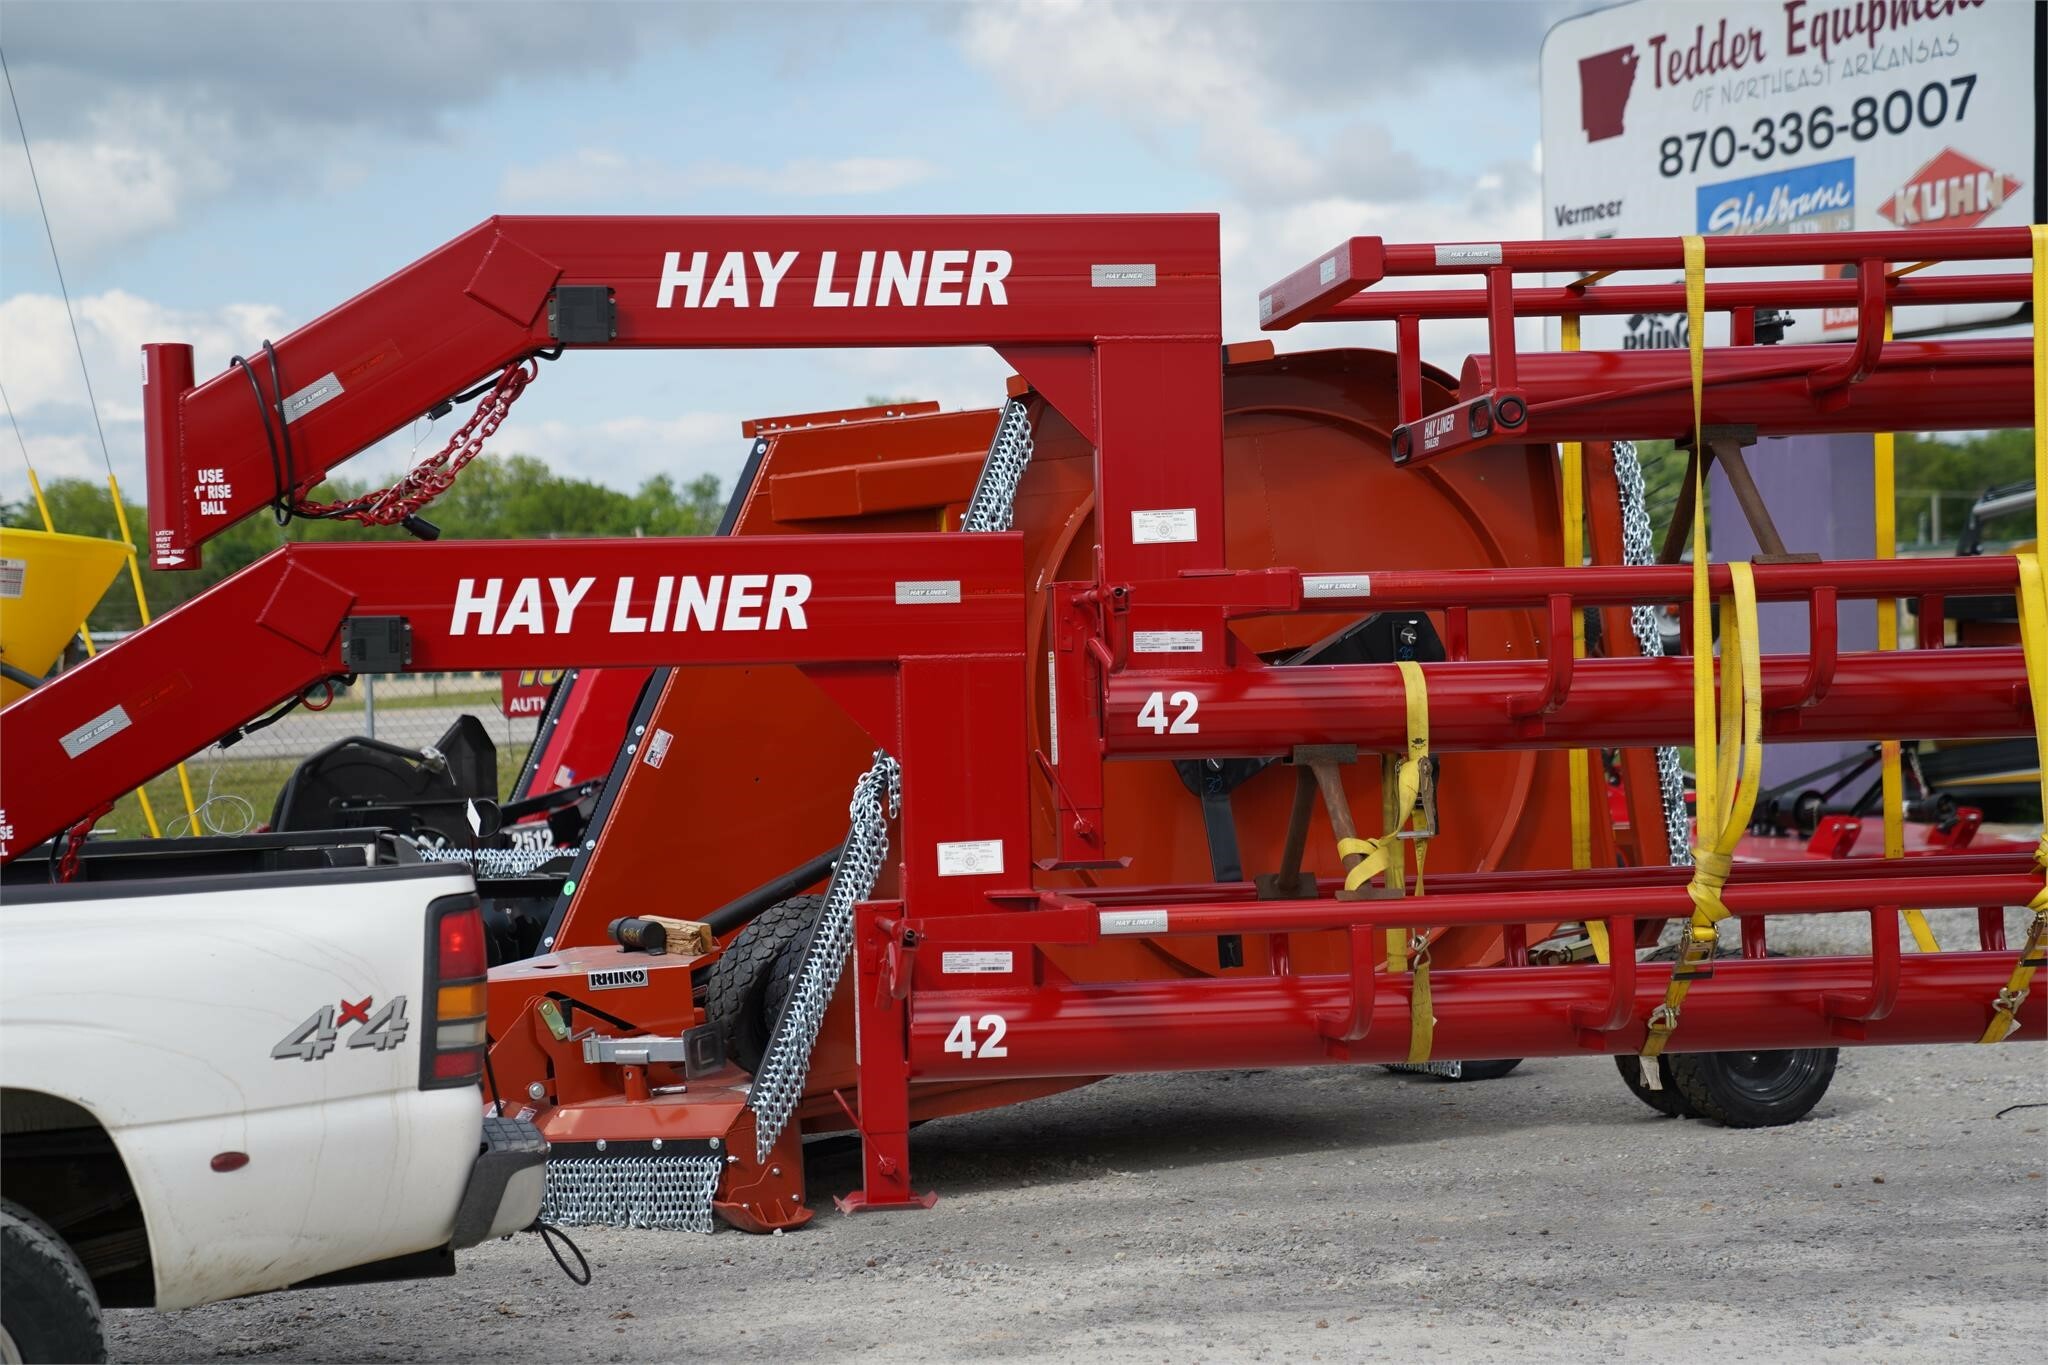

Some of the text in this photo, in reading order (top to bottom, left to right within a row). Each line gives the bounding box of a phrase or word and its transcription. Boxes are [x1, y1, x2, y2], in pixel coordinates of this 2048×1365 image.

[1648, 0, 1986, 90] Tedder Equipme
[1692, 32, 1960, 113] OF NORTHEAST ARKANSAS
[1658, 73, 1978, 179] 870-336-8007
[1555, 199, 1623, 227] Vermeer
[1708, 181, 1852, 236] Shelbourne
[1895, 171, 2004, 227] KUHN
[657, 250, 1013, 308] HAY LINER
[292, 386, 329, 412] HAY LINER
[1424, 413, 1455, 440] HAY LINER
[1424, 436, 1440, 450] TRAILERS
[194, 484, 232, 500] 1" RISE
[197, 468, 225, 484] USE
[200, 500, 227, 515] BALL
[449, 573, 812, 636] HAY LINER
[1137, 690, 1200, 735] 42
[511, 828, 555, 852] 2512
[590, 969, 646, 987] RHINO
[944, 1013, 1008, 1059] 42
